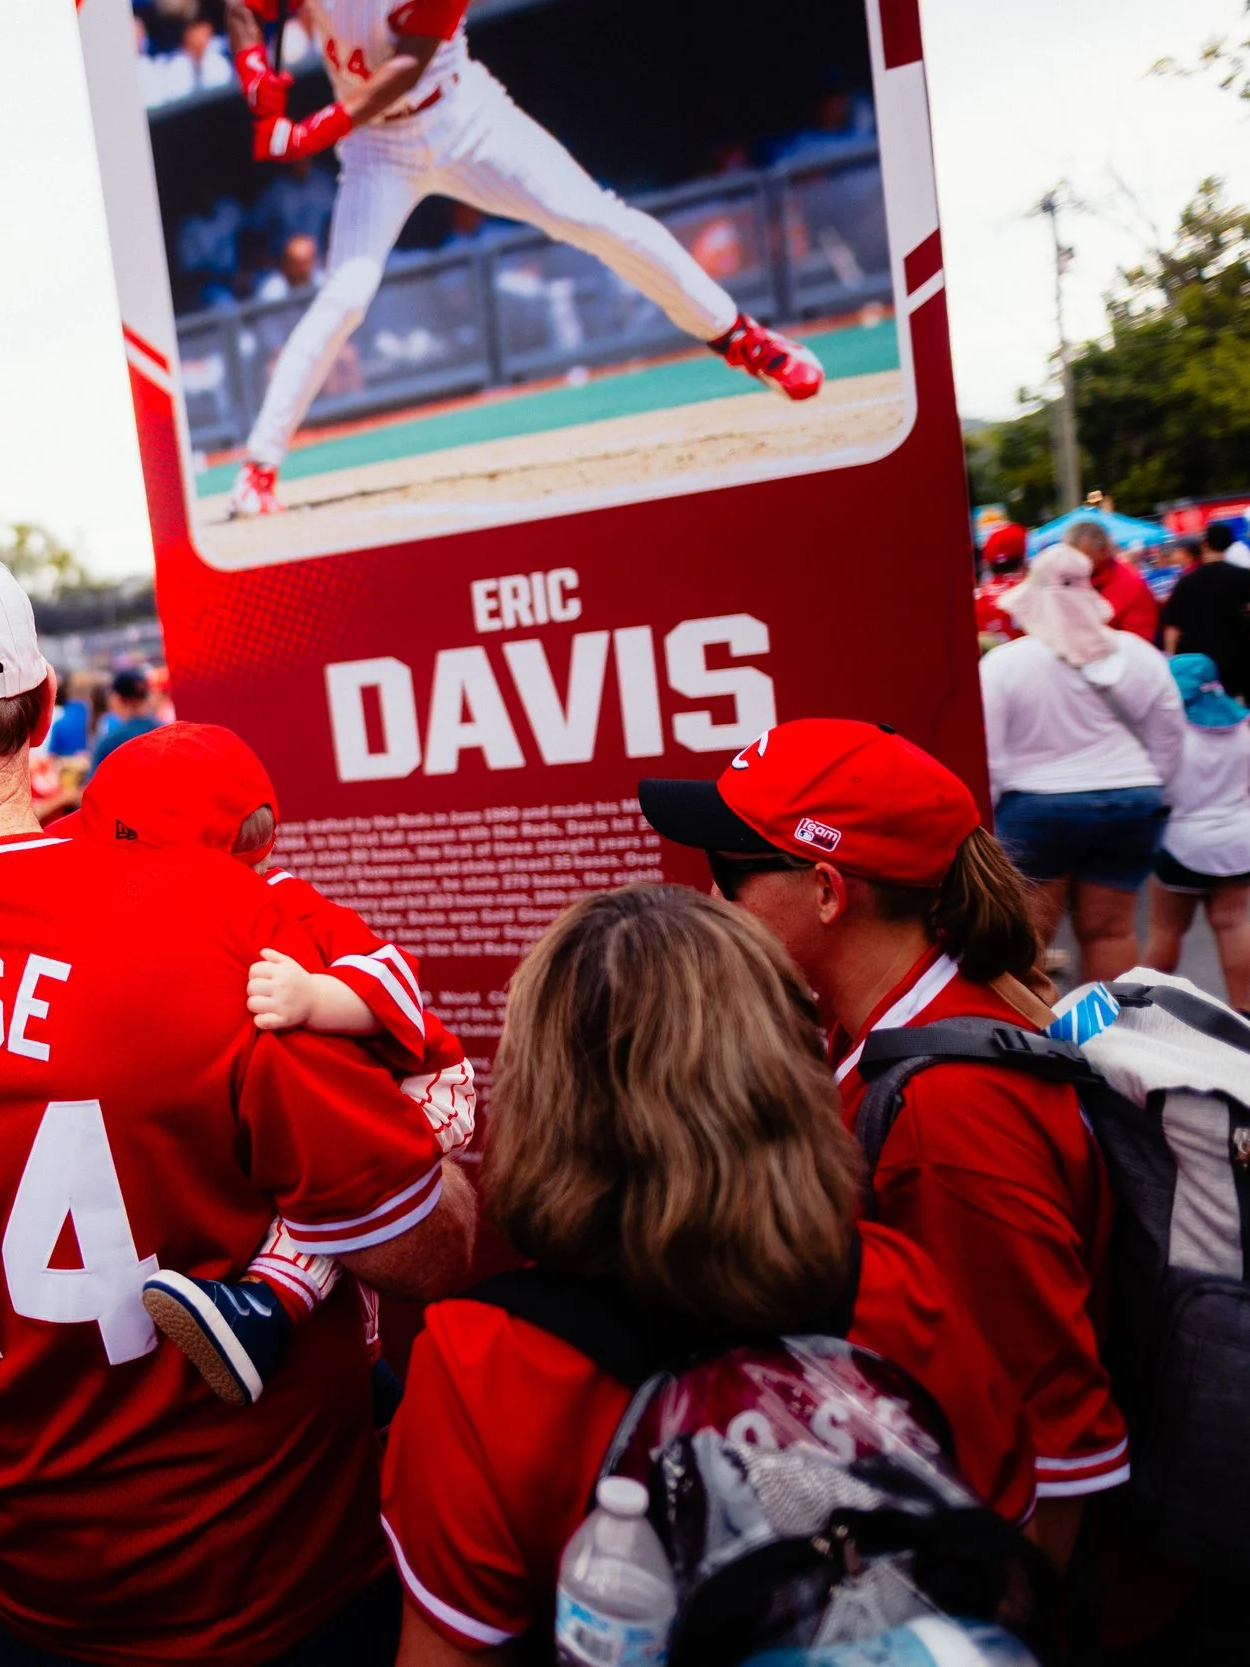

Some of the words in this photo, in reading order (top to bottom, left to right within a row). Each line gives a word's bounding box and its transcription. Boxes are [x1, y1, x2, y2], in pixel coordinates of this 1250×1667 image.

[471, 566, 582, 633] ERIC
[325, 612, 778, 783] DAVIS
[803, 818, 838, 841] Team
